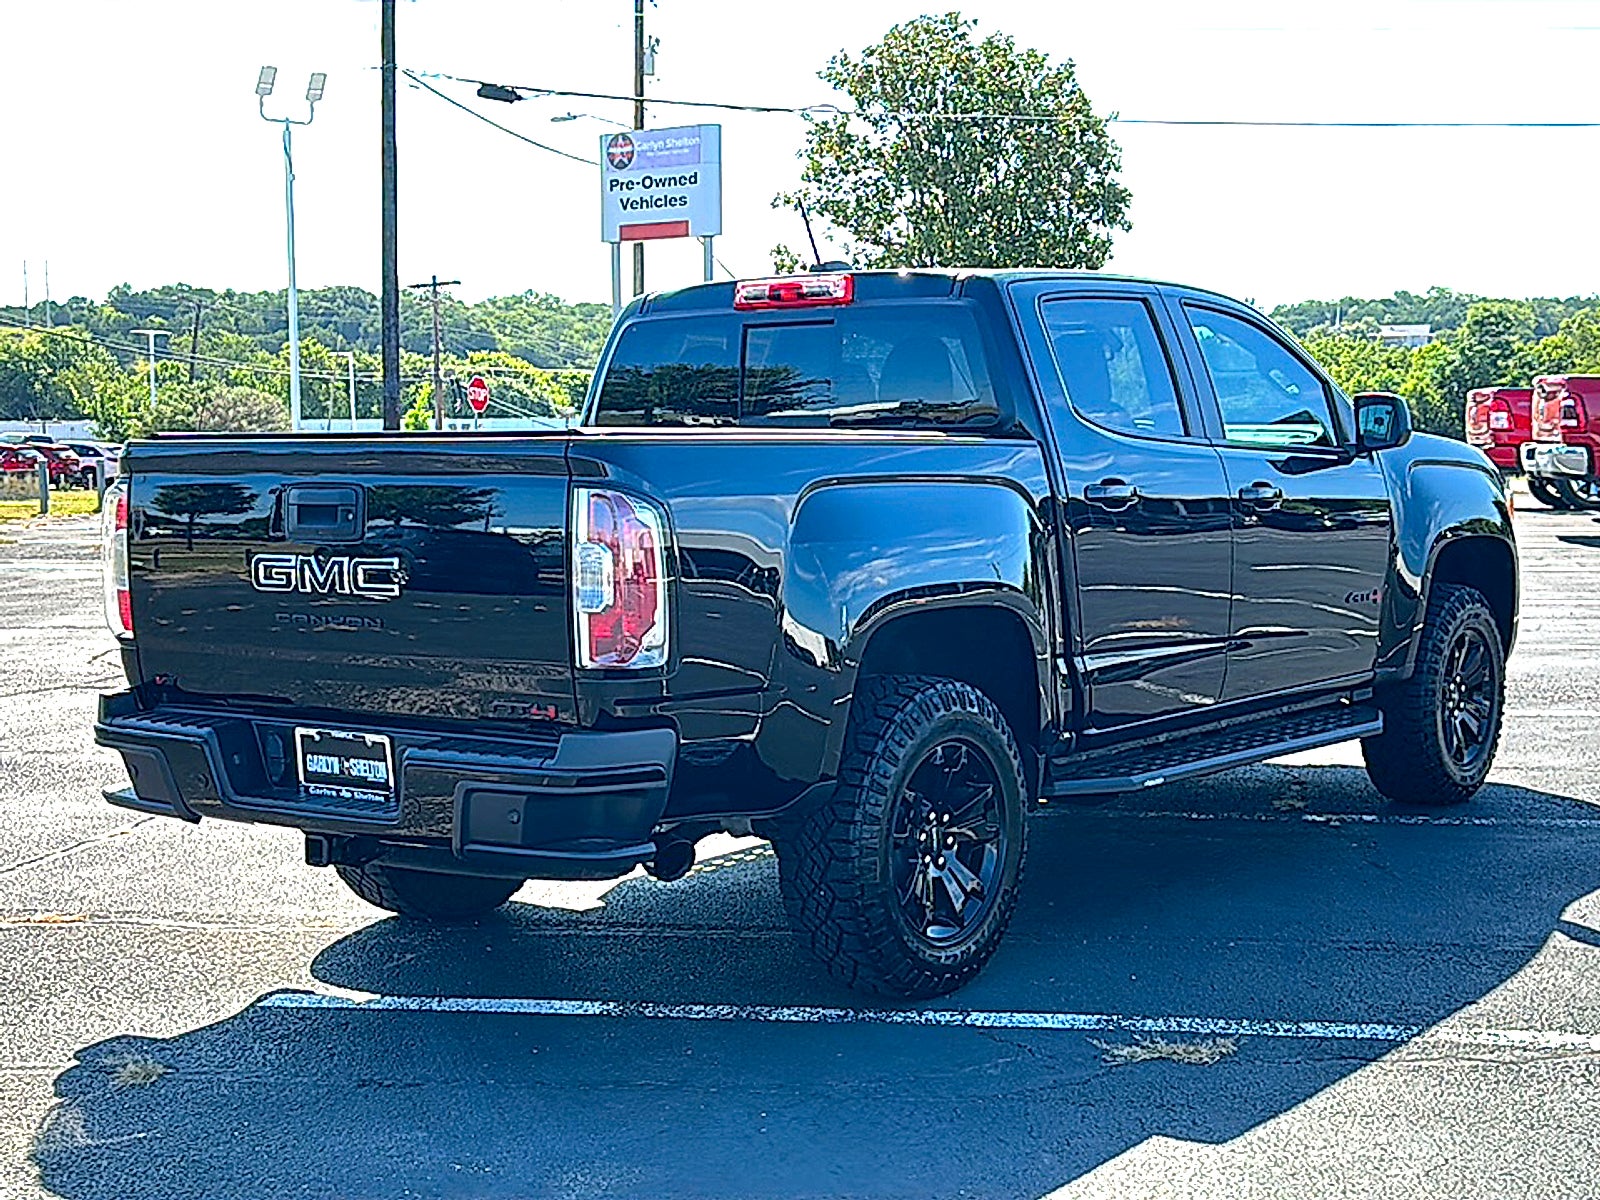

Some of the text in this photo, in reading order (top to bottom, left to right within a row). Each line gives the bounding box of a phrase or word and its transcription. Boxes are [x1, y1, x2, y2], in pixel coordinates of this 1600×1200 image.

[609, 172, 698, 192] Pre-Owned
[619, 195, 688, 211] Vehicles
[469, 387, 488, 401] STOP
[251, 554, 399, 596] GMC
[275, 613, 383, 628] CANYON
[350, 758, 387, 780] SHELTON
